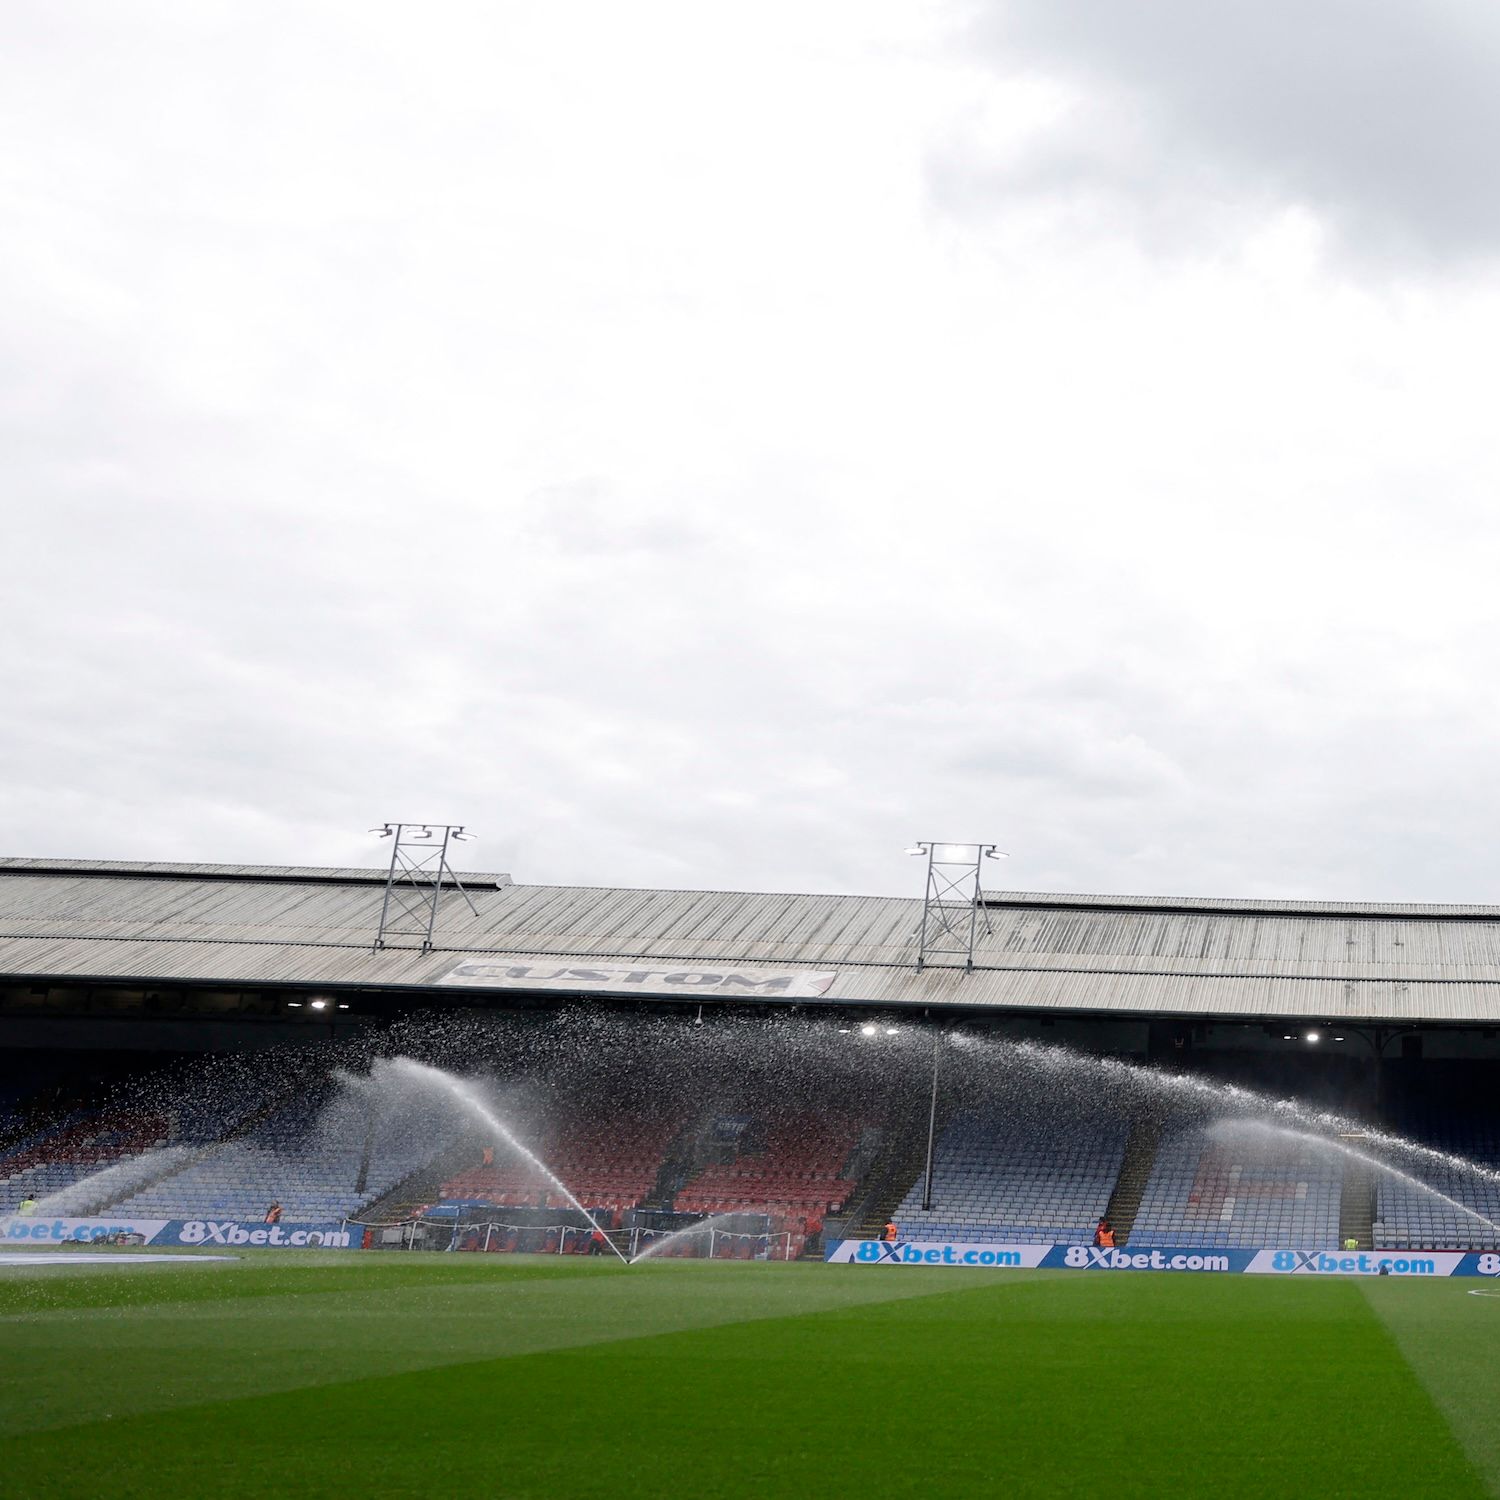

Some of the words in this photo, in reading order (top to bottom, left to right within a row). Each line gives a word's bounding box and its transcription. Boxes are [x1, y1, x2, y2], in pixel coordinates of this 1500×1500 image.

[454, 964, 793, 989] CUSTOM
[179, 1221, 350, 1246] 8Xbet.com
[856, 1241, 1021, 1265] 8Xbet.com
[1064, 1246, 1229, 1271] 8Xbet.com
[1271, 1251, 1435, 1275] 8Xbet.com
